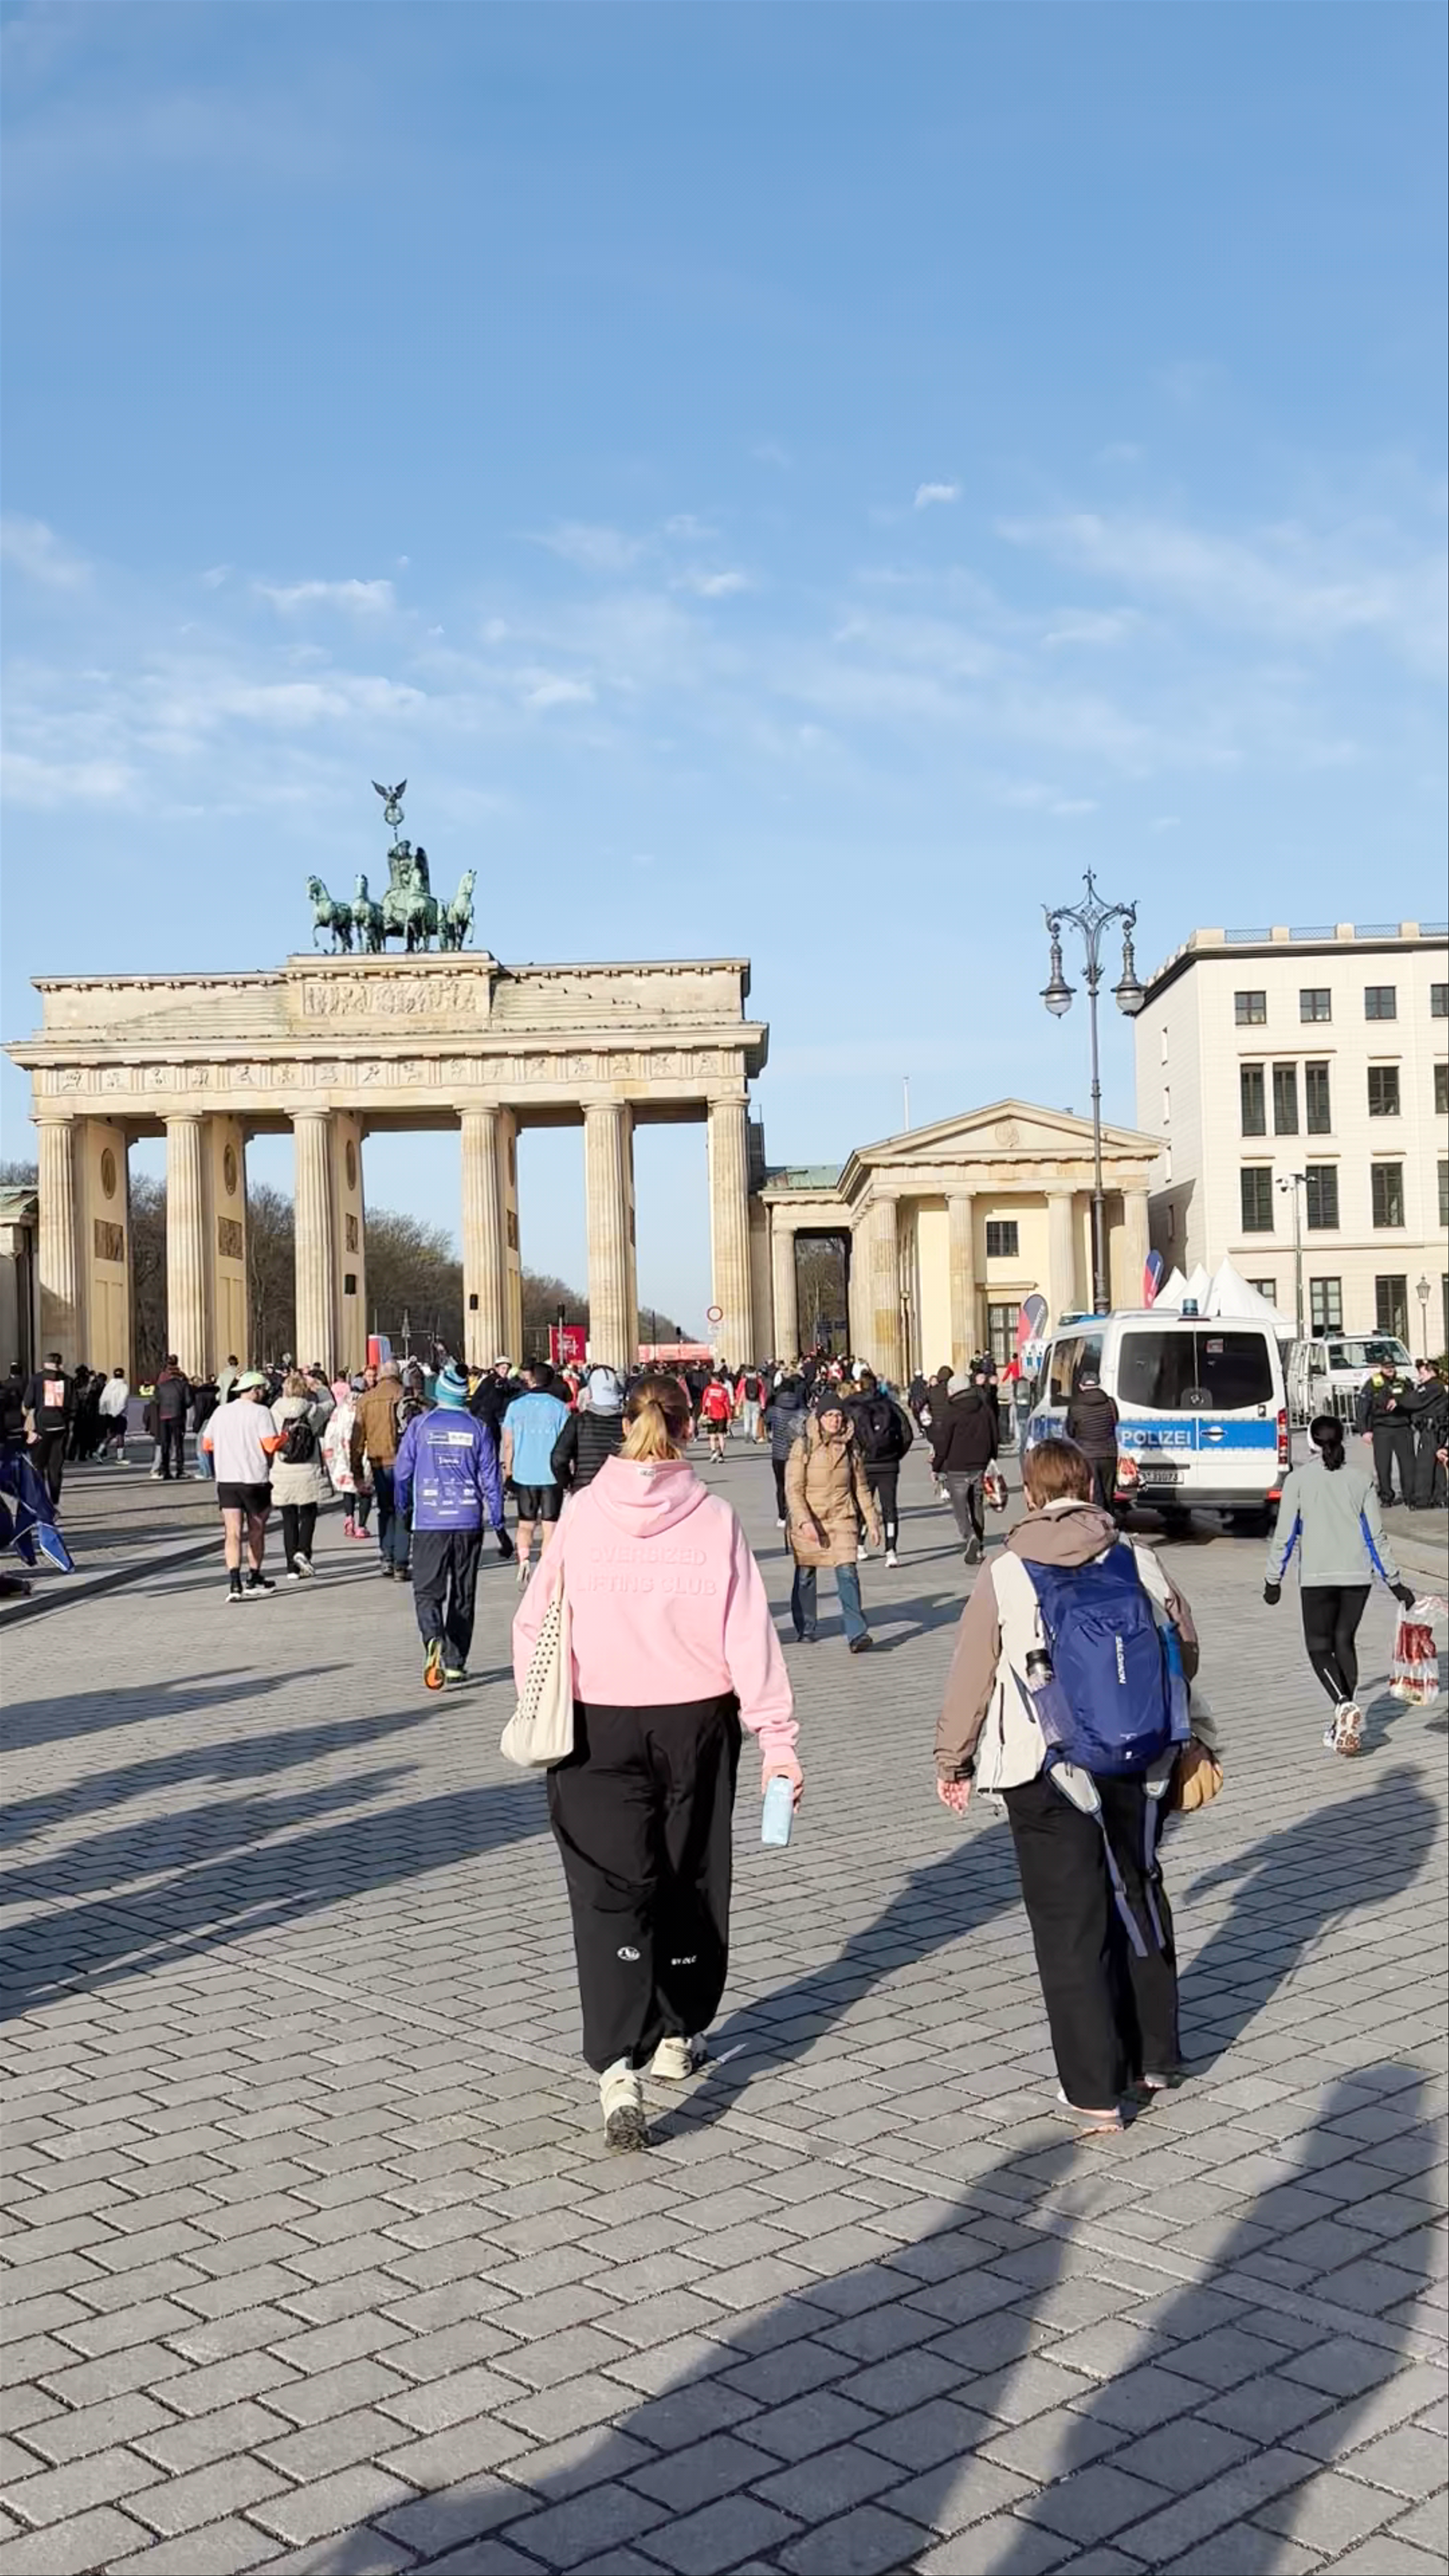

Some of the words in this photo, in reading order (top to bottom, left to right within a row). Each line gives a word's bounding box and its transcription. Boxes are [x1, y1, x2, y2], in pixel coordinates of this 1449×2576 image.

[1121, 1430, 1191, 1445] POLIZEI
[591, 1545, 707, 1566] OVERSIZED
[577, 1571, 654, 1593] LIFTING
[661, 1576, 717, 1596] CLUB
[1115, 1636, 1127, 1684] SALOMON
